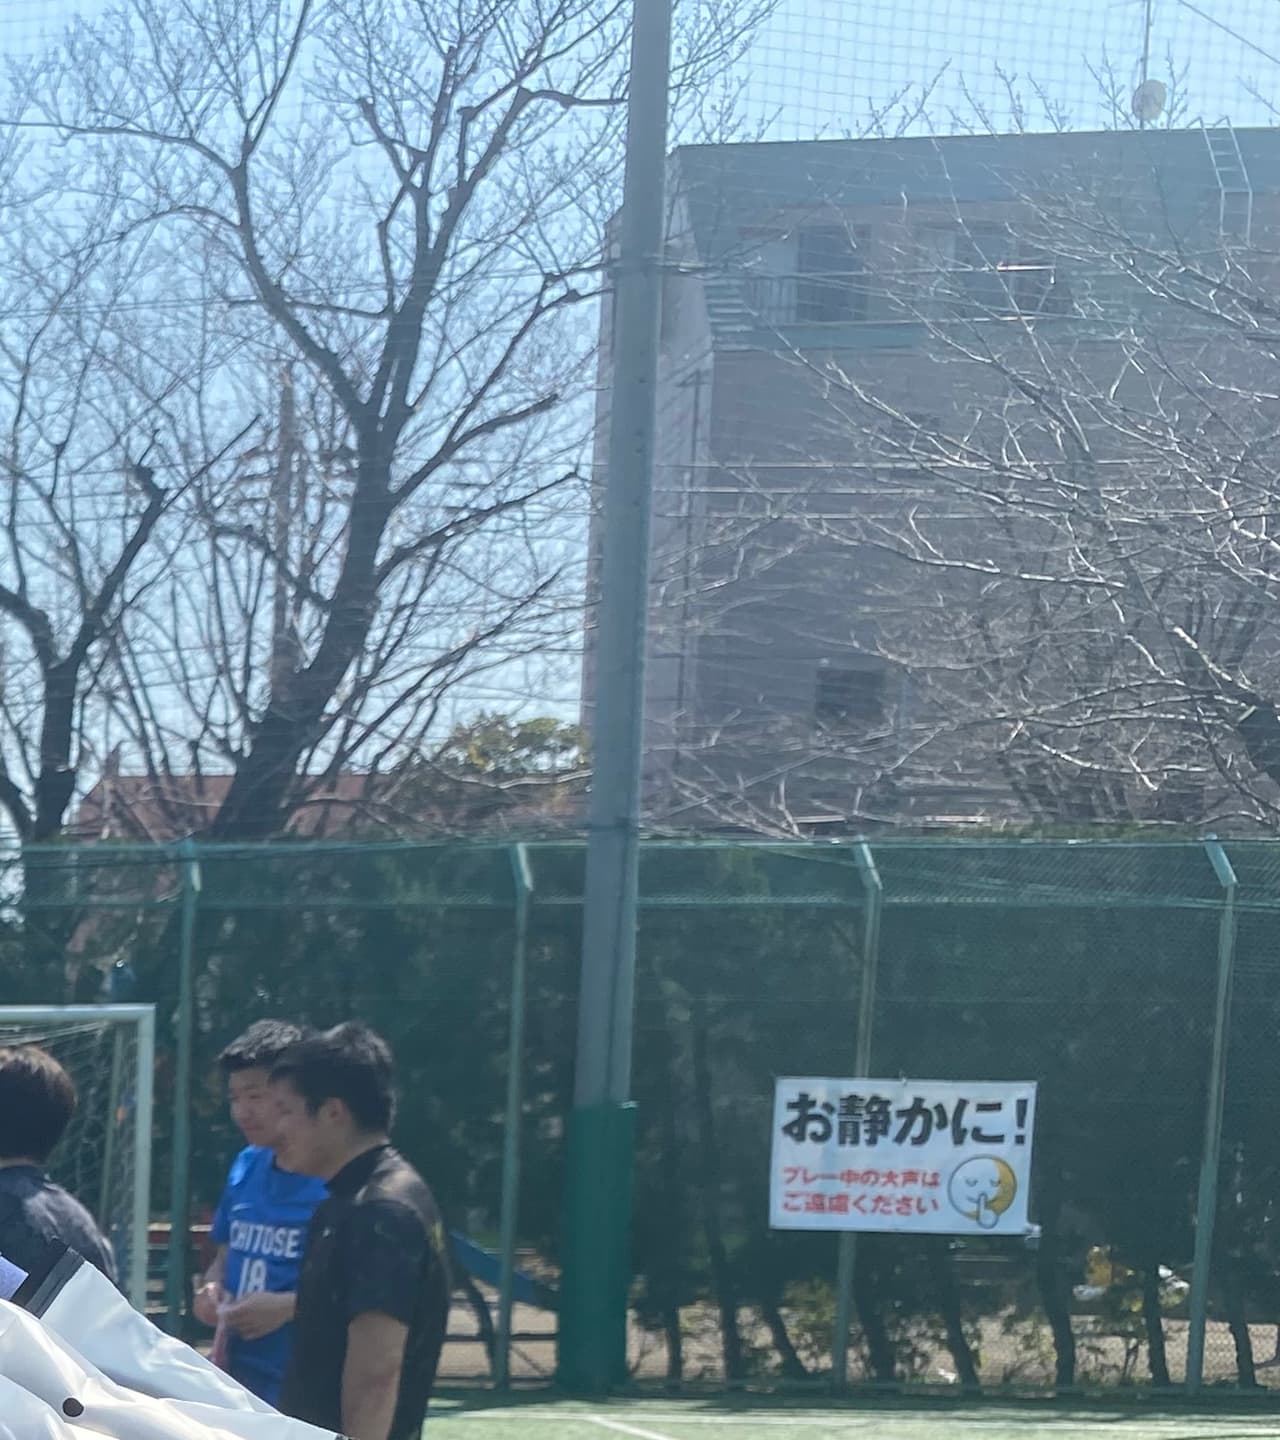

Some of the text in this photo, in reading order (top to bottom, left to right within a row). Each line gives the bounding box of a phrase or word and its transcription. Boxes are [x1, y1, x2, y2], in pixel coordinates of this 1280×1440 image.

[782, 1167, 940, 1189] プレー中の大声は
[782, 1192, 939, 1216] ご遠慮ください
[229, 1220, 301, 1258] CHITOSE
